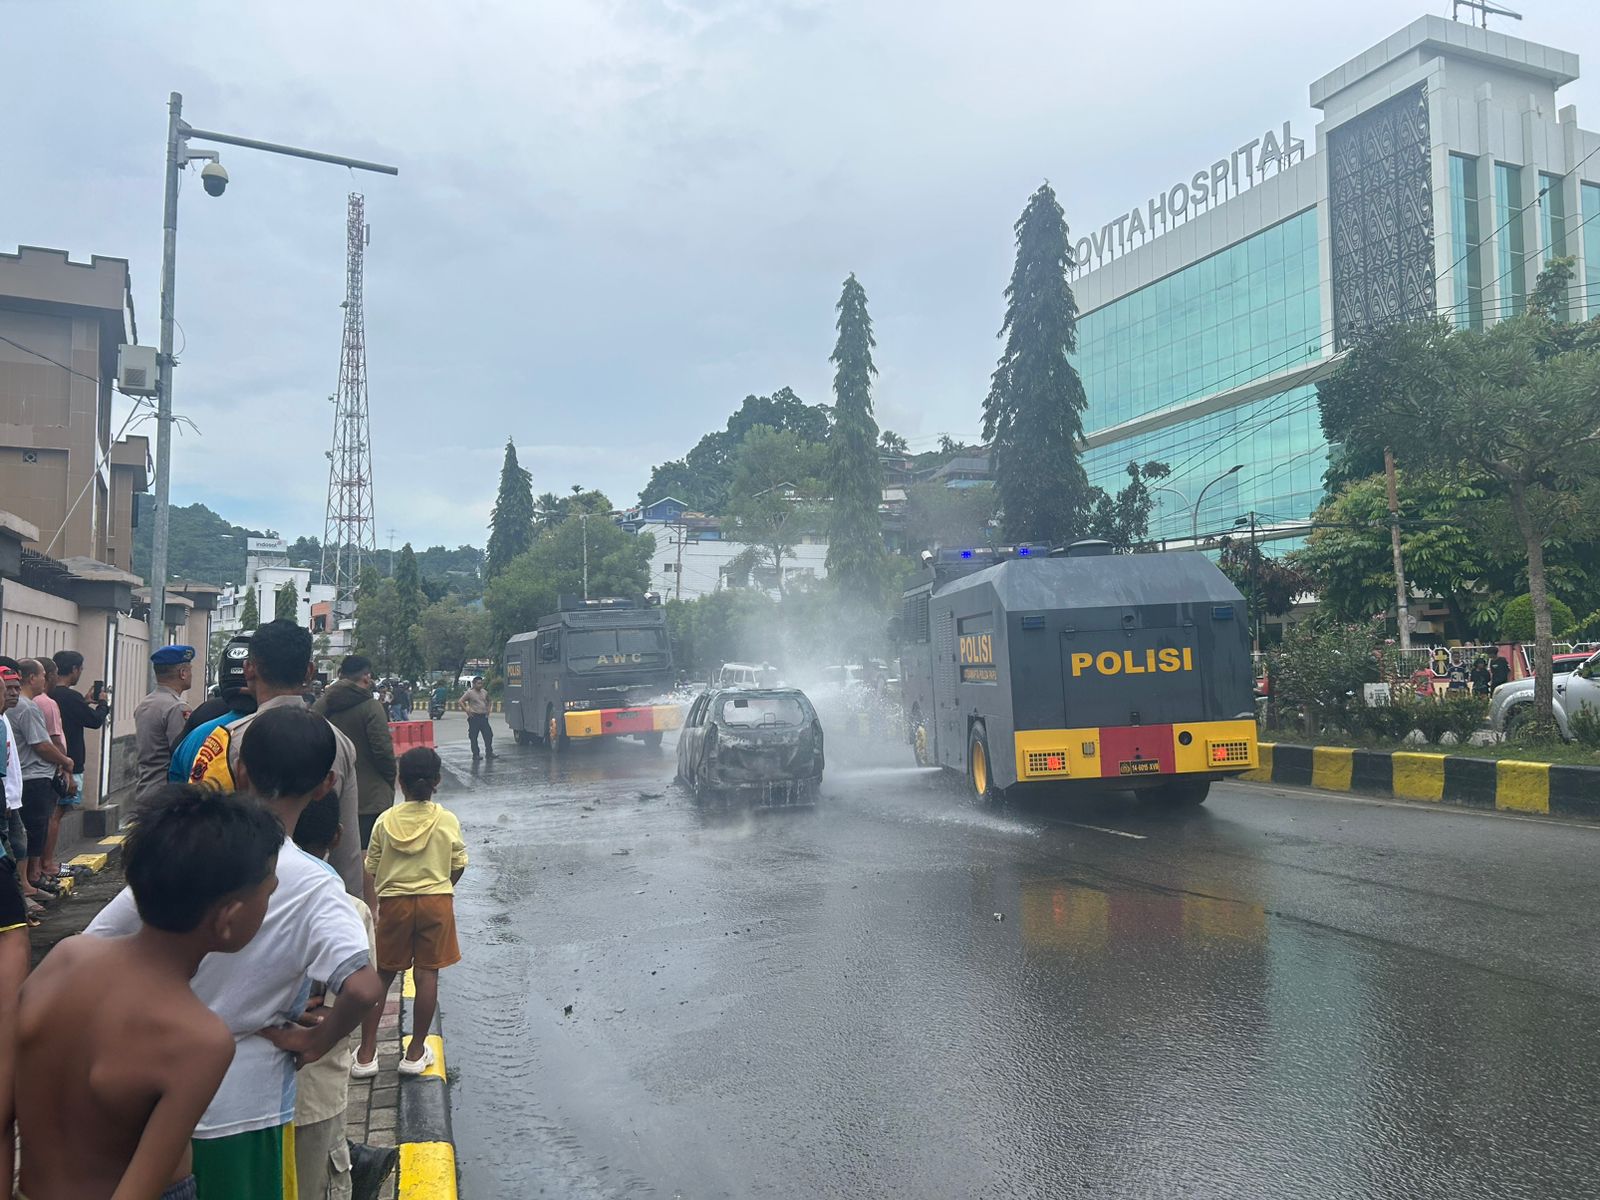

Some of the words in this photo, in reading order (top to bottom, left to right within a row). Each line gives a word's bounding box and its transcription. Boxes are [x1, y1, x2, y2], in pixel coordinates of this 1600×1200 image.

[1070, 207, 1145, 268] OVITA
[1148, 120, 1303, 229] HOSPITAL
[960, 634, 993, 664] POLISI
[1071, 647, 1193, 677] POLISI
